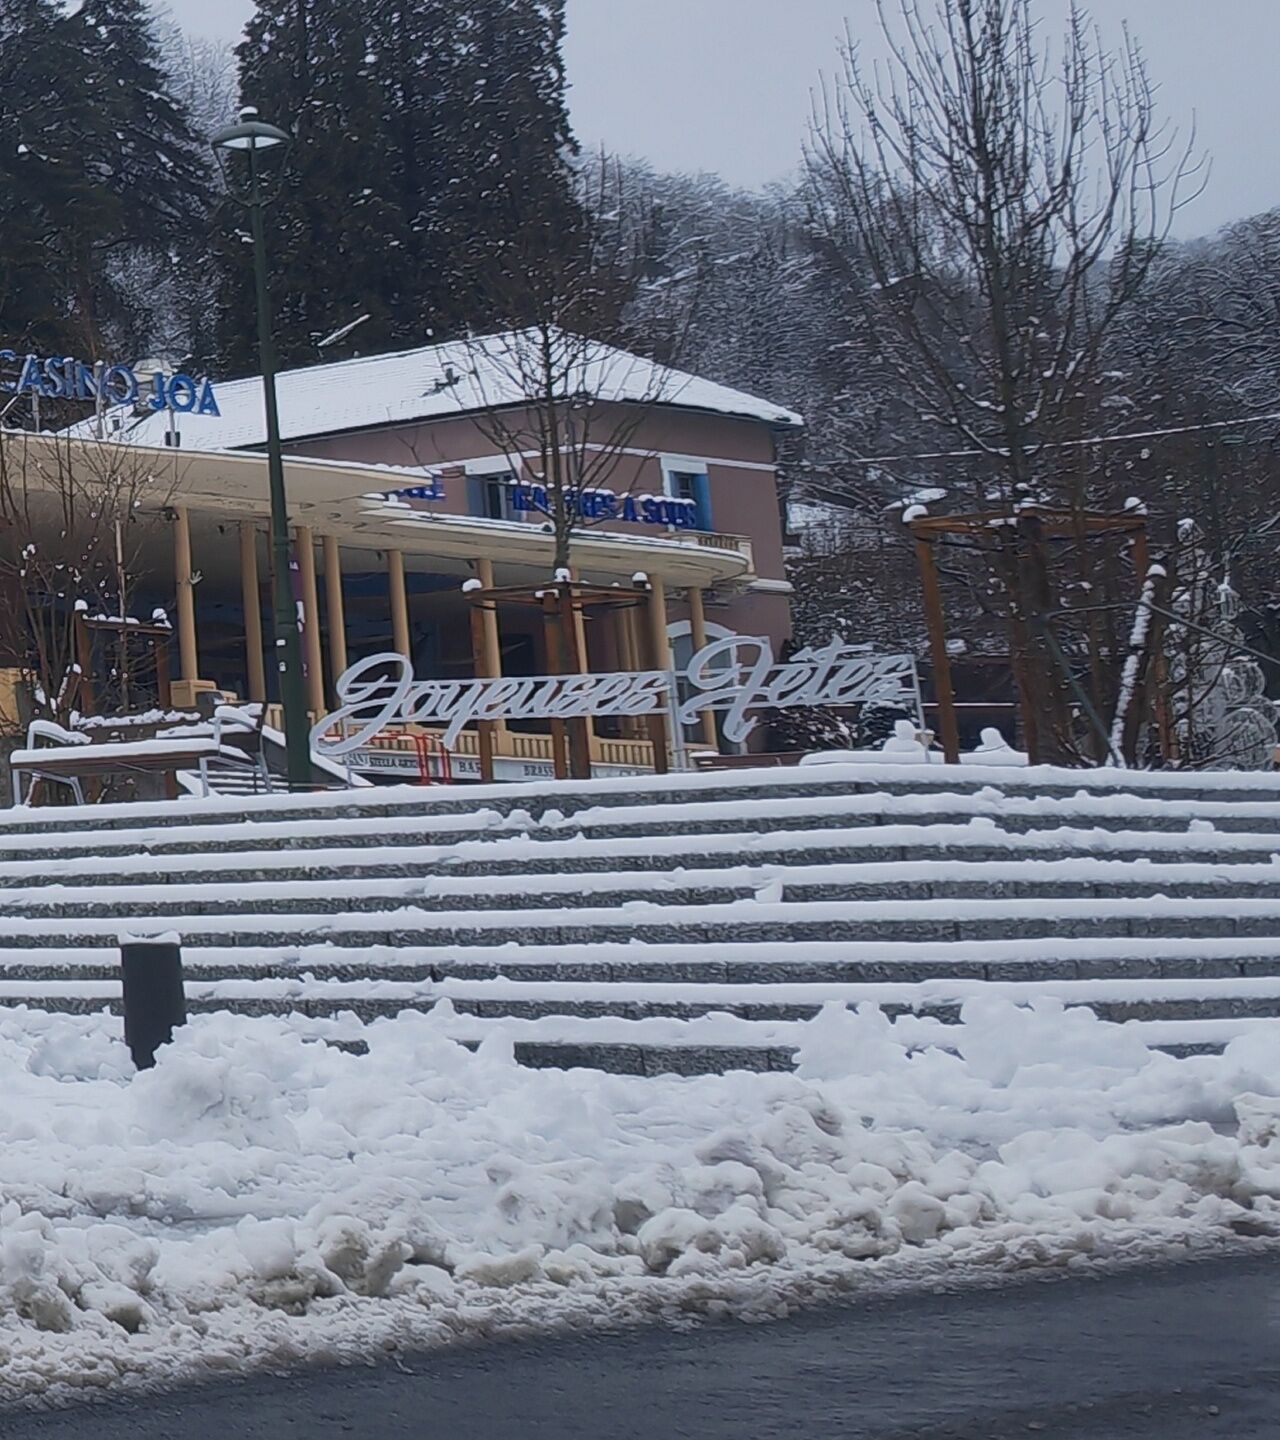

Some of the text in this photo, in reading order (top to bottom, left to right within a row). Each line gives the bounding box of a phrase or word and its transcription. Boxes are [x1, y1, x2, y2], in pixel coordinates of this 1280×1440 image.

[148, 371, 222, 417] JOA
[309, 652, 671, 756] Joyeuses
[523, 765, 555, 777] BRASS
